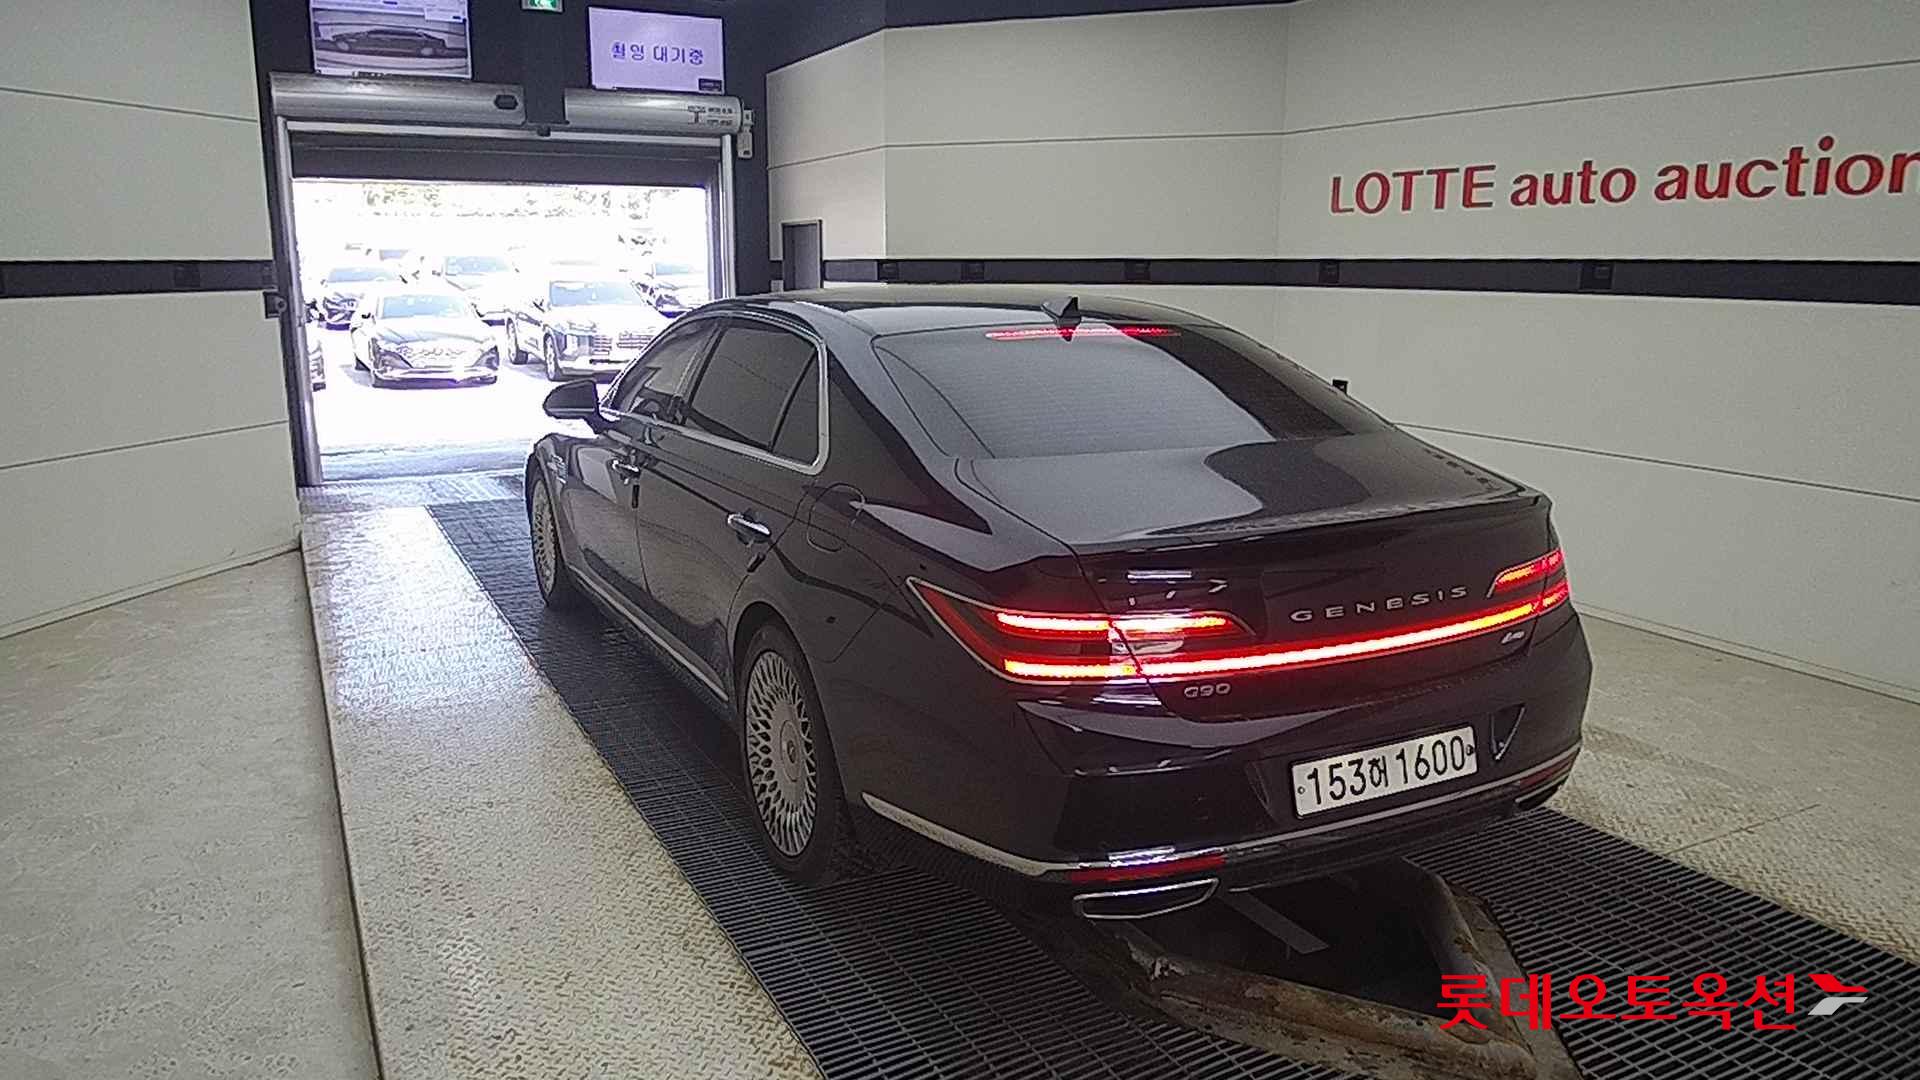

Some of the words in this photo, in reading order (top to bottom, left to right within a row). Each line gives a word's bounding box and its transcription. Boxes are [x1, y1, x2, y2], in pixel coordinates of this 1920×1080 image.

[653, 45, 704, 66] 대기중
[1330, 164, 1497, 214] LOTTE
[1510, 160, 1636, 206] auto
[1290, 586, 1468, 622] GENESIS
[1184, 683, 1231, 698] G90
